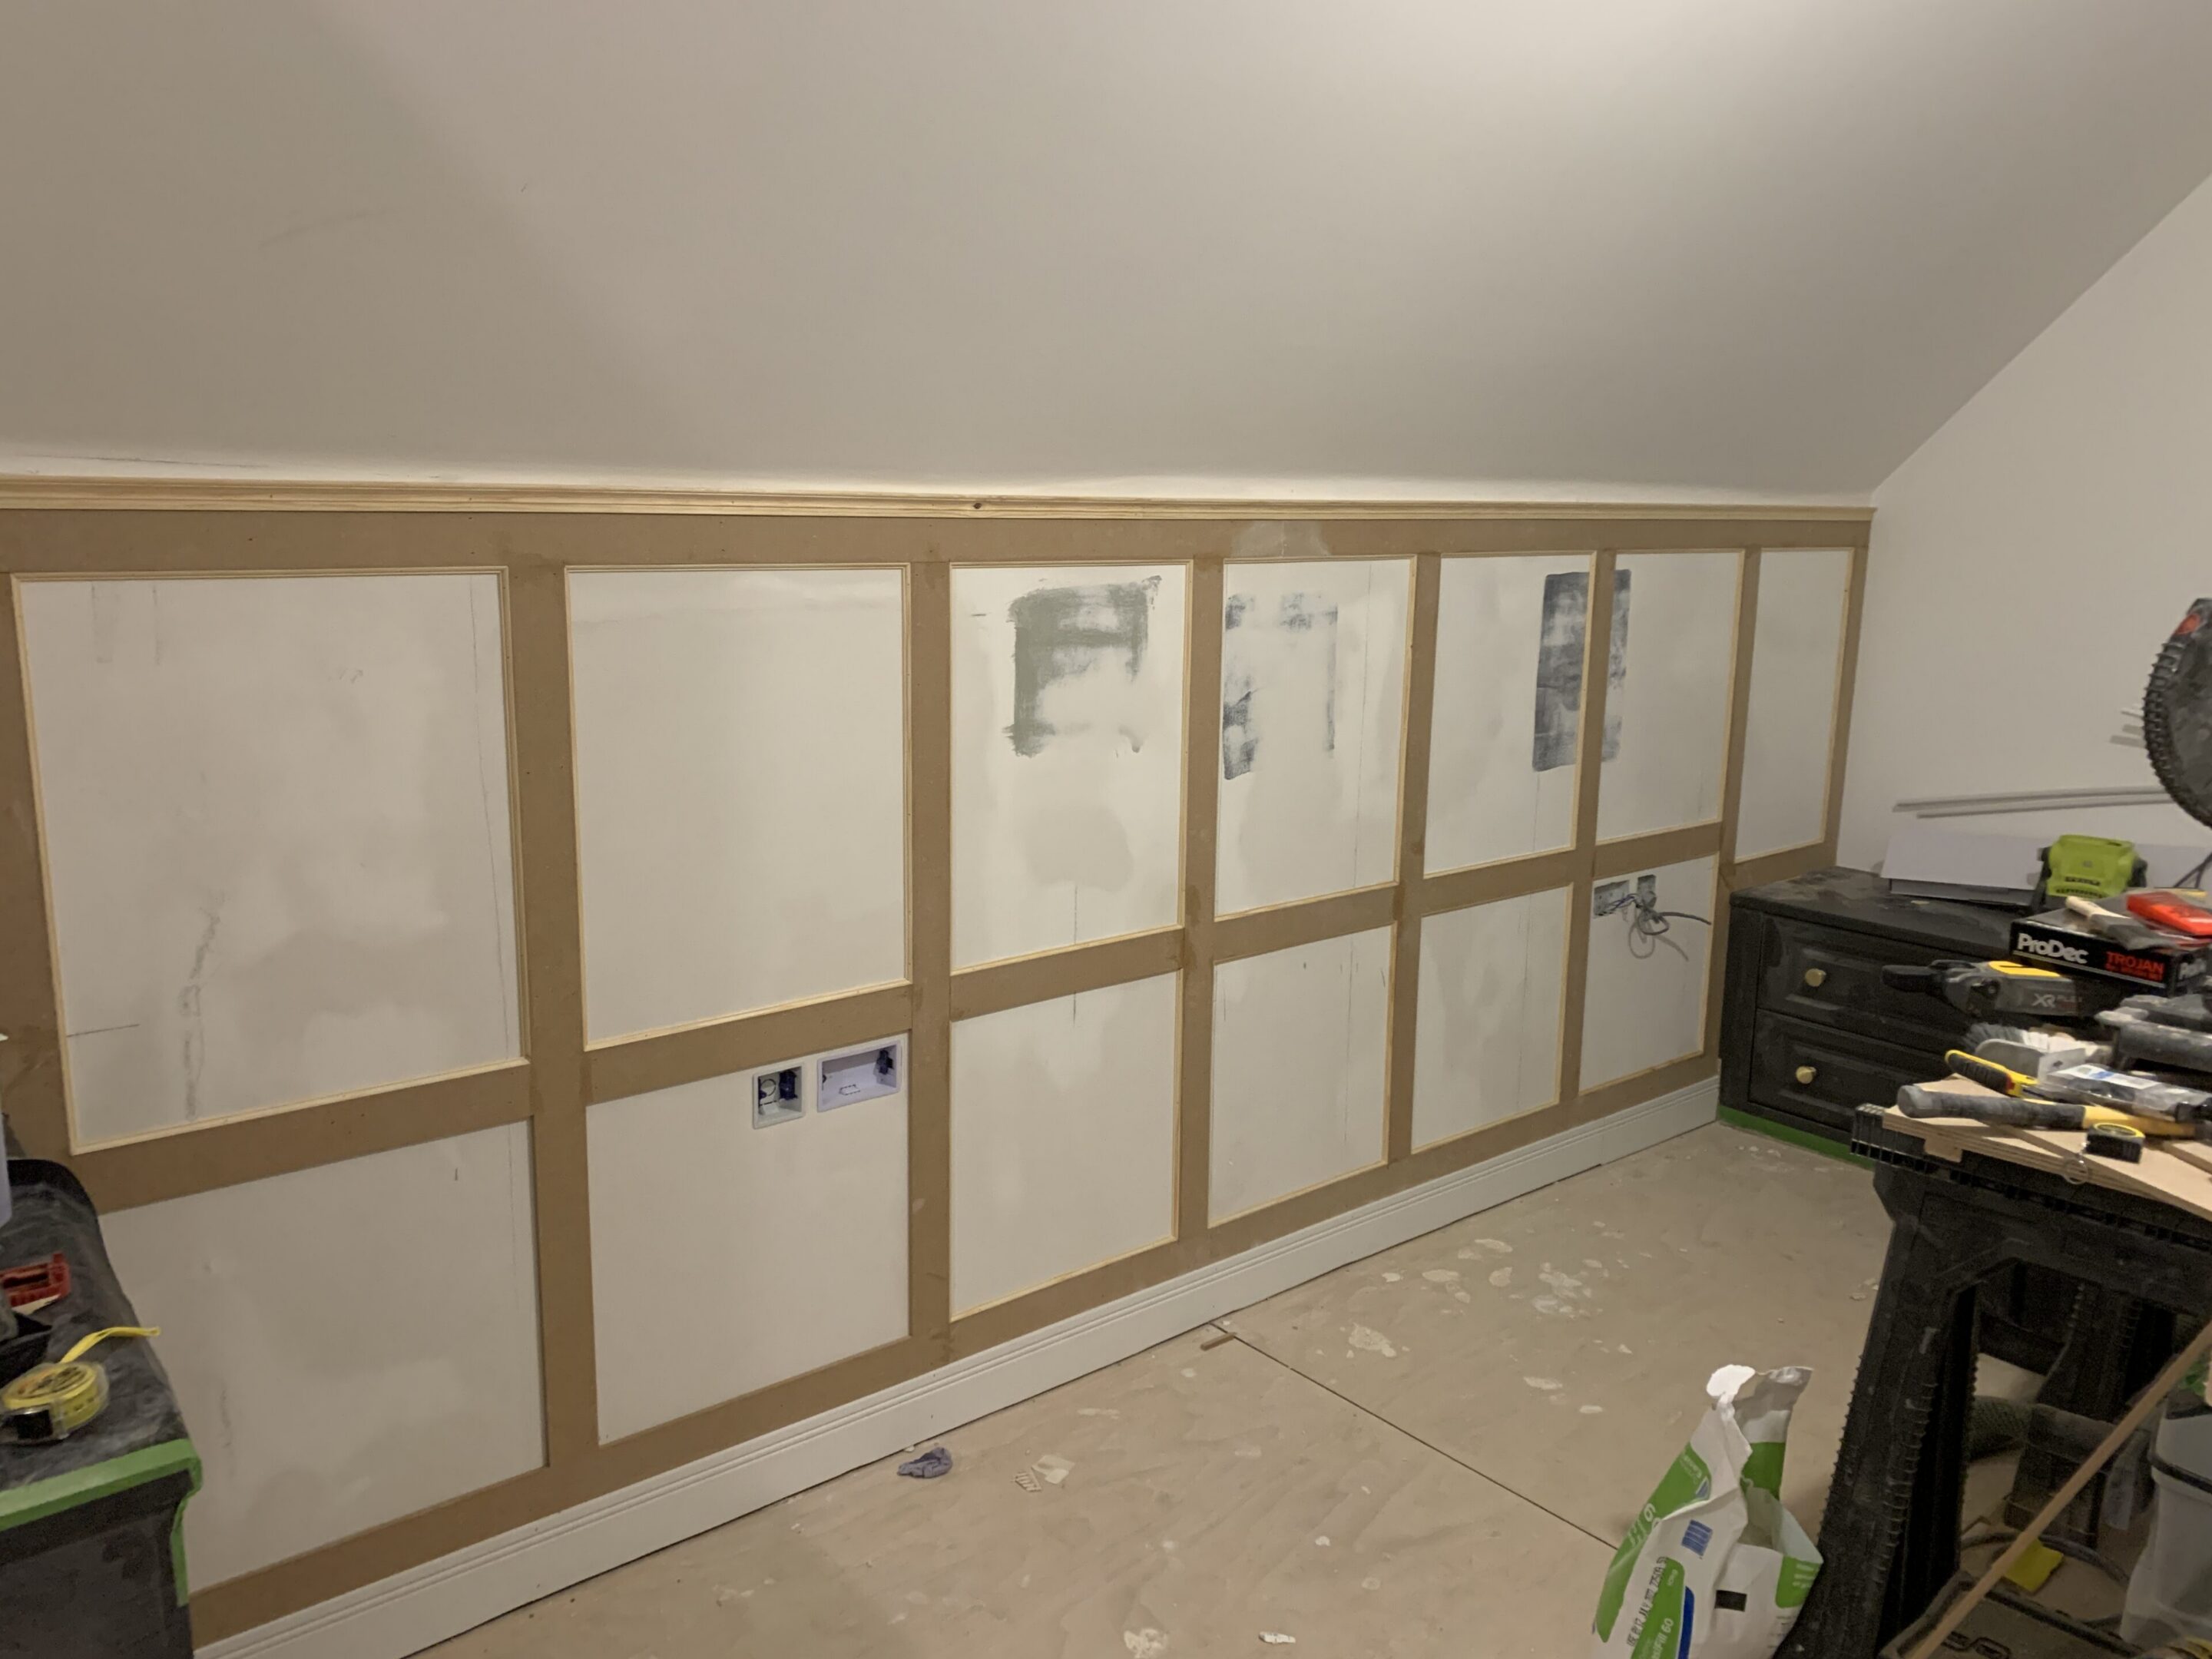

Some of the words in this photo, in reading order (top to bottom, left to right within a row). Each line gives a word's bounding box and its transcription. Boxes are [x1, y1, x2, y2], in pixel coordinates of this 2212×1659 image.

[2018, 932, 2088, 964] ProDec
[2107, 952, 2164, 974] TROJAN
[1661, 1618, 1674, 1634] 60
